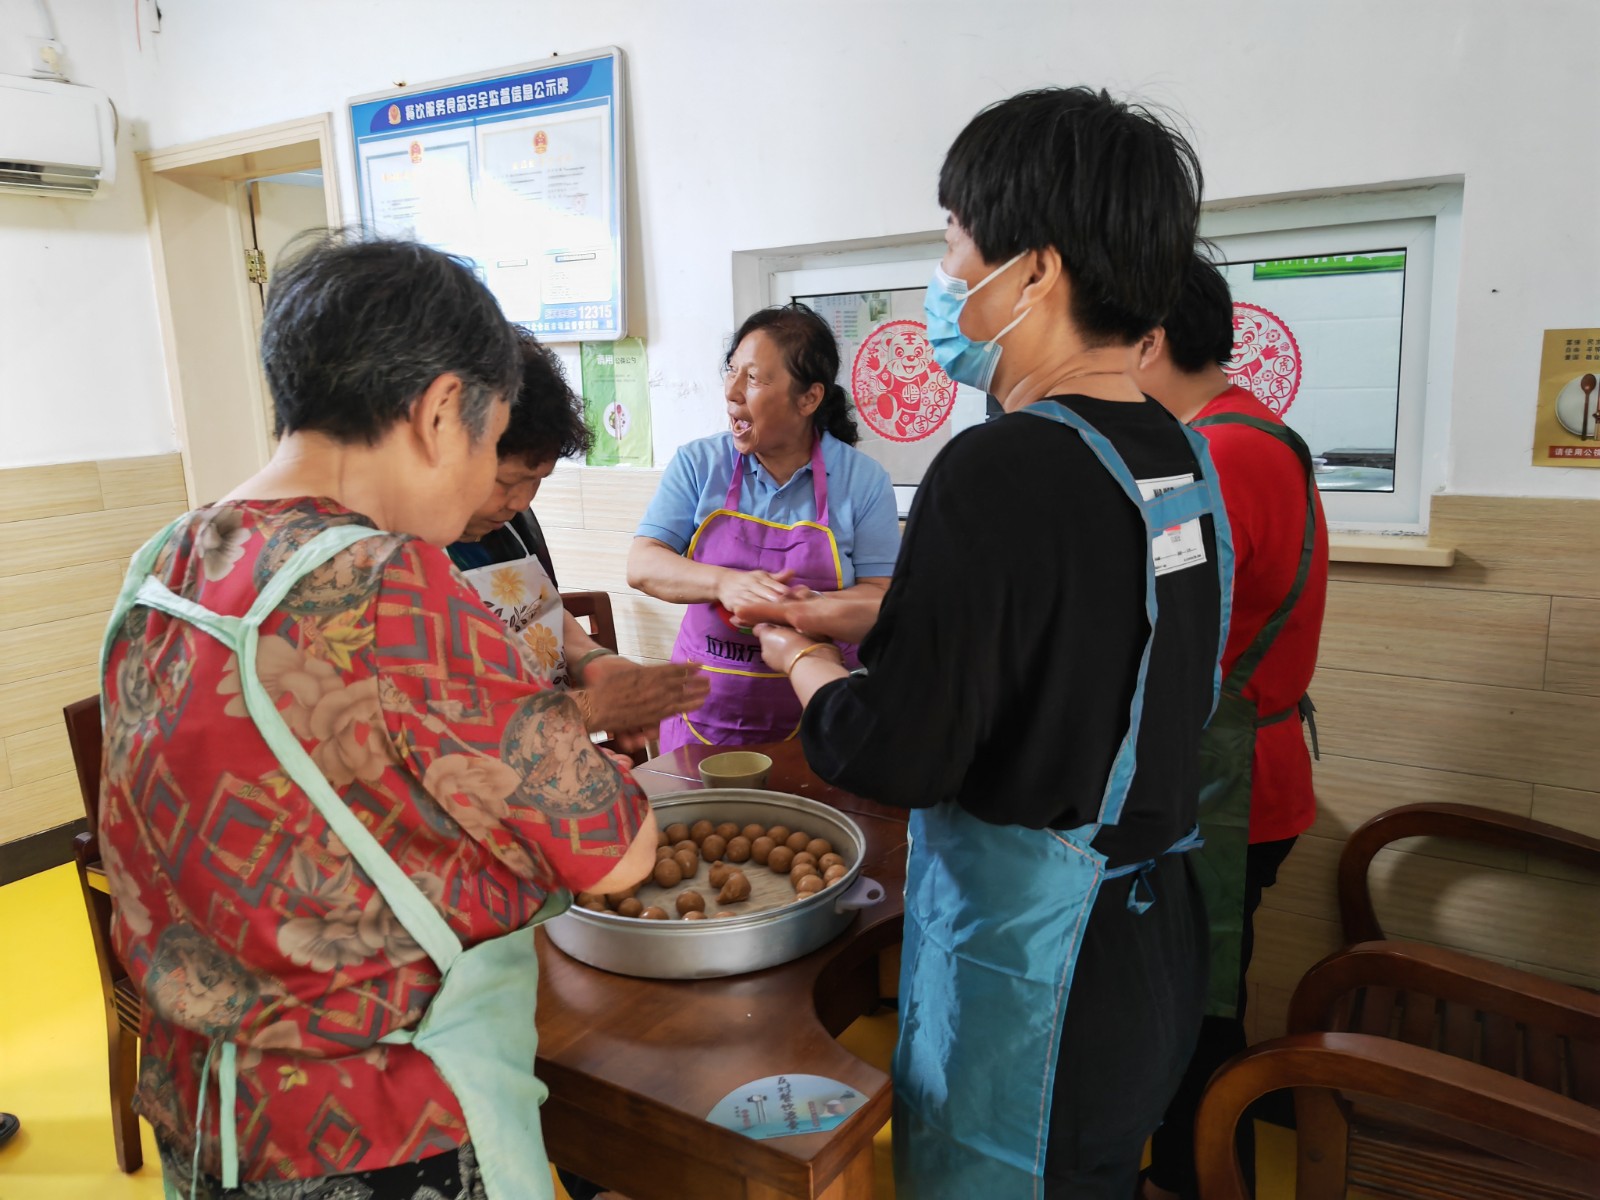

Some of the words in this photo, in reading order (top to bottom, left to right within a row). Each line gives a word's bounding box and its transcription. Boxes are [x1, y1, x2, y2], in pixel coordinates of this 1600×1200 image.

[405, 77, 569, 121] 餐饮服务食品安全监督信息公示牌
[578, 304, 612, 319] 12315
